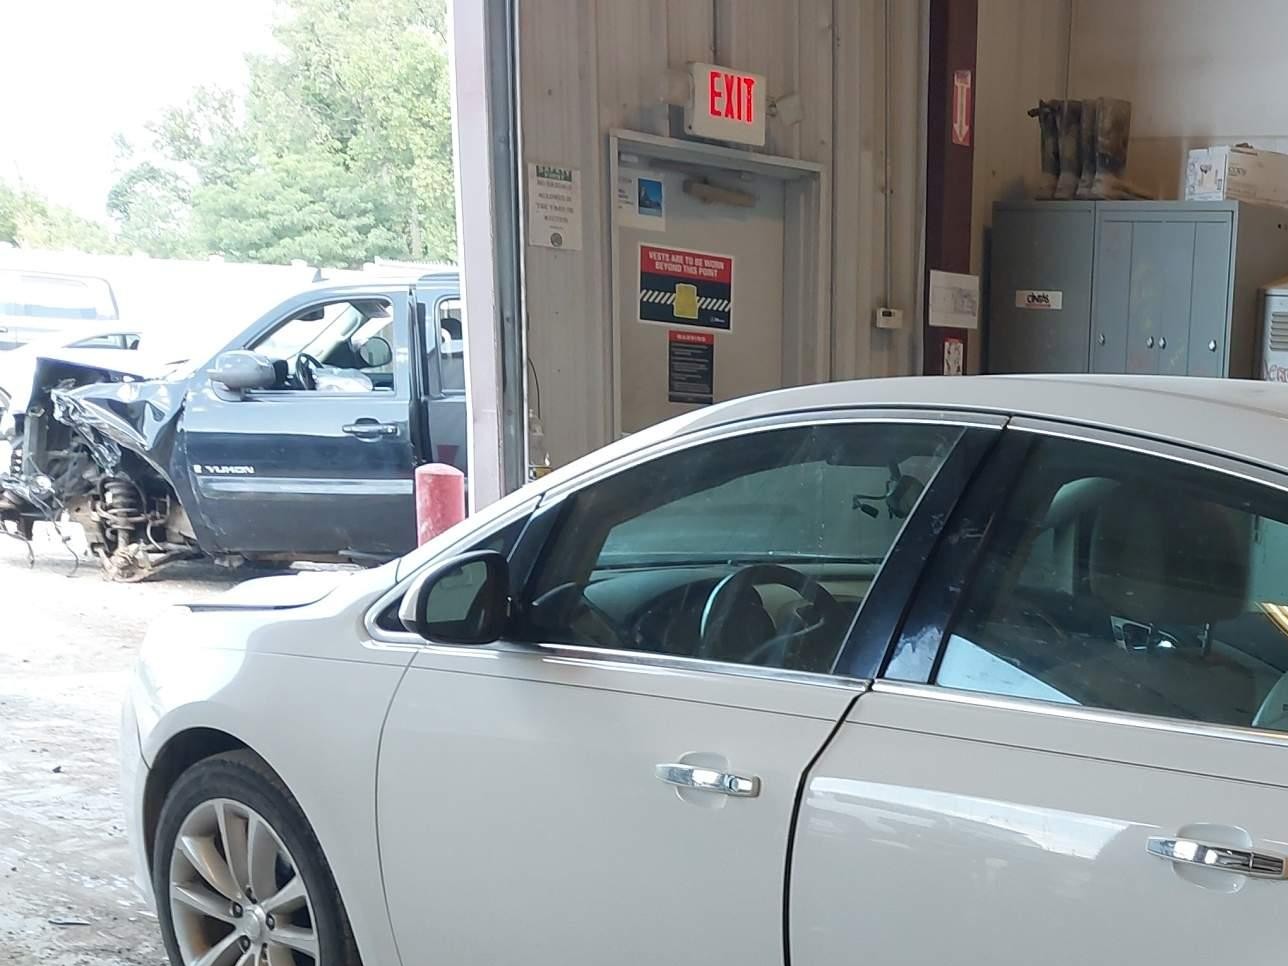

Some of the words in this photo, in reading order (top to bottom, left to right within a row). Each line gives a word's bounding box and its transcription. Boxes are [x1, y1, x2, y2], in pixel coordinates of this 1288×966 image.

[709, 71, 755, 122] EXIT
[648, 251, 670, 262] VESTS
[671, 254, 684, 265] ARE
[684, 256, 694, 267] TO
[694, 257, 704, 268] BE
[704, 259, 725, 270] WORN
[655, 261, 682, 273] BEYOND
[682, 264, 698, 276] THIS
[698, 267, 718, 278] POINT
[204, 465, 255, 474] YUKON
